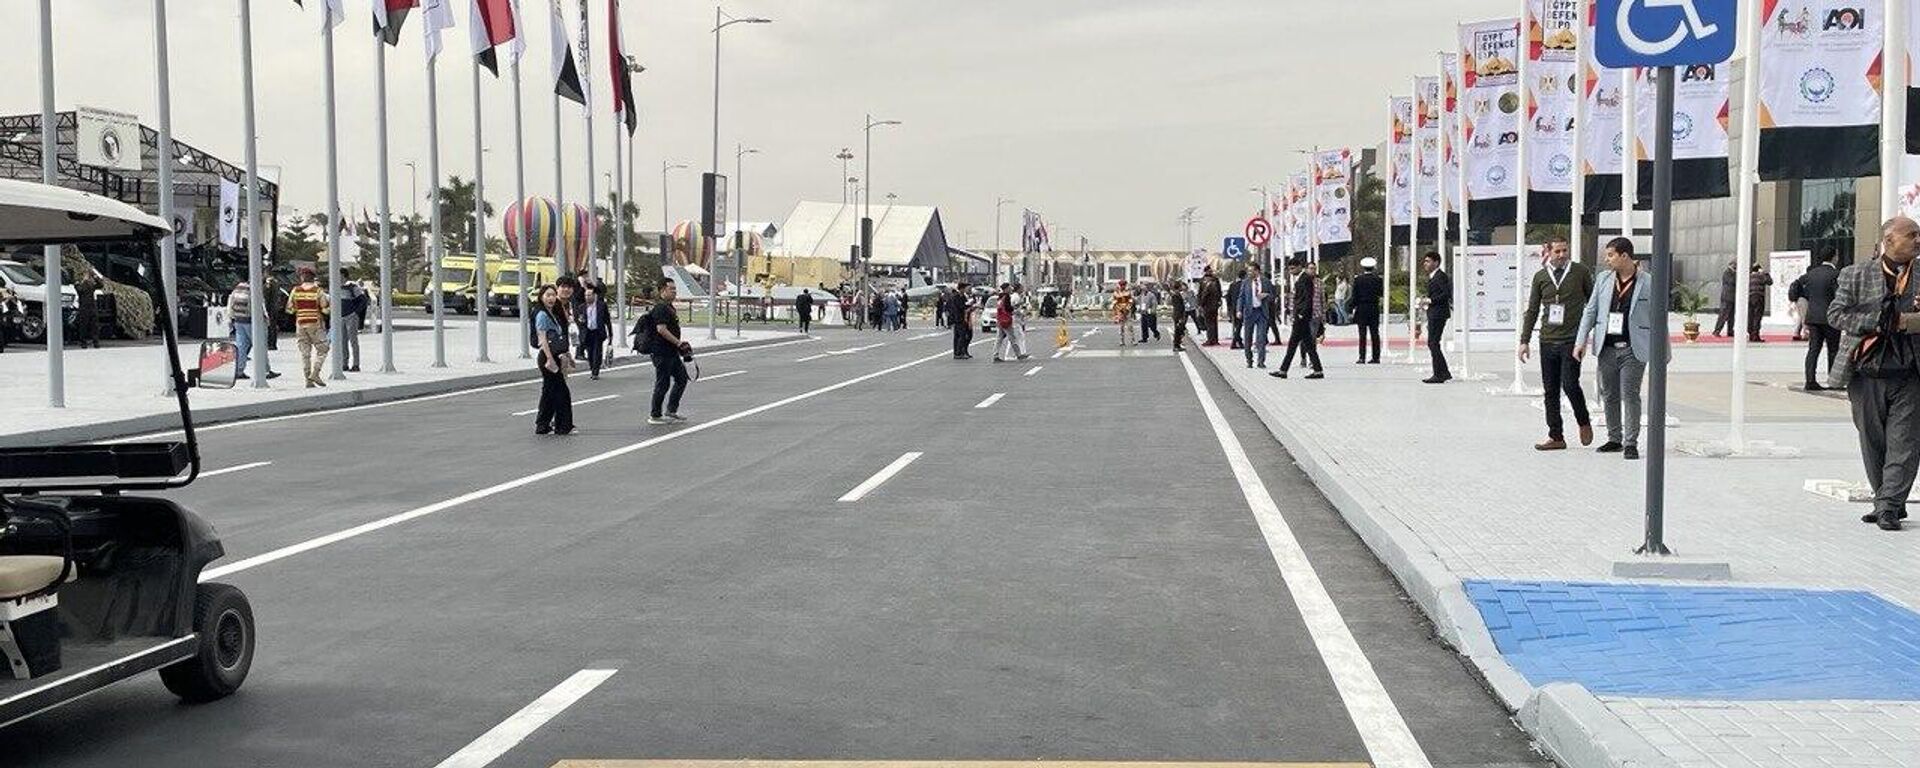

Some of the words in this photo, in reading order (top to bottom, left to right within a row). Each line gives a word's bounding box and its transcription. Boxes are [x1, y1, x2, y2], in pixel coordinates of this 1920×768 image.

[1546, 10, 1577, 20] DEFEN
[1822, 8, 1865, 31] AOI
[1498, 131, 1518, 145] AO
